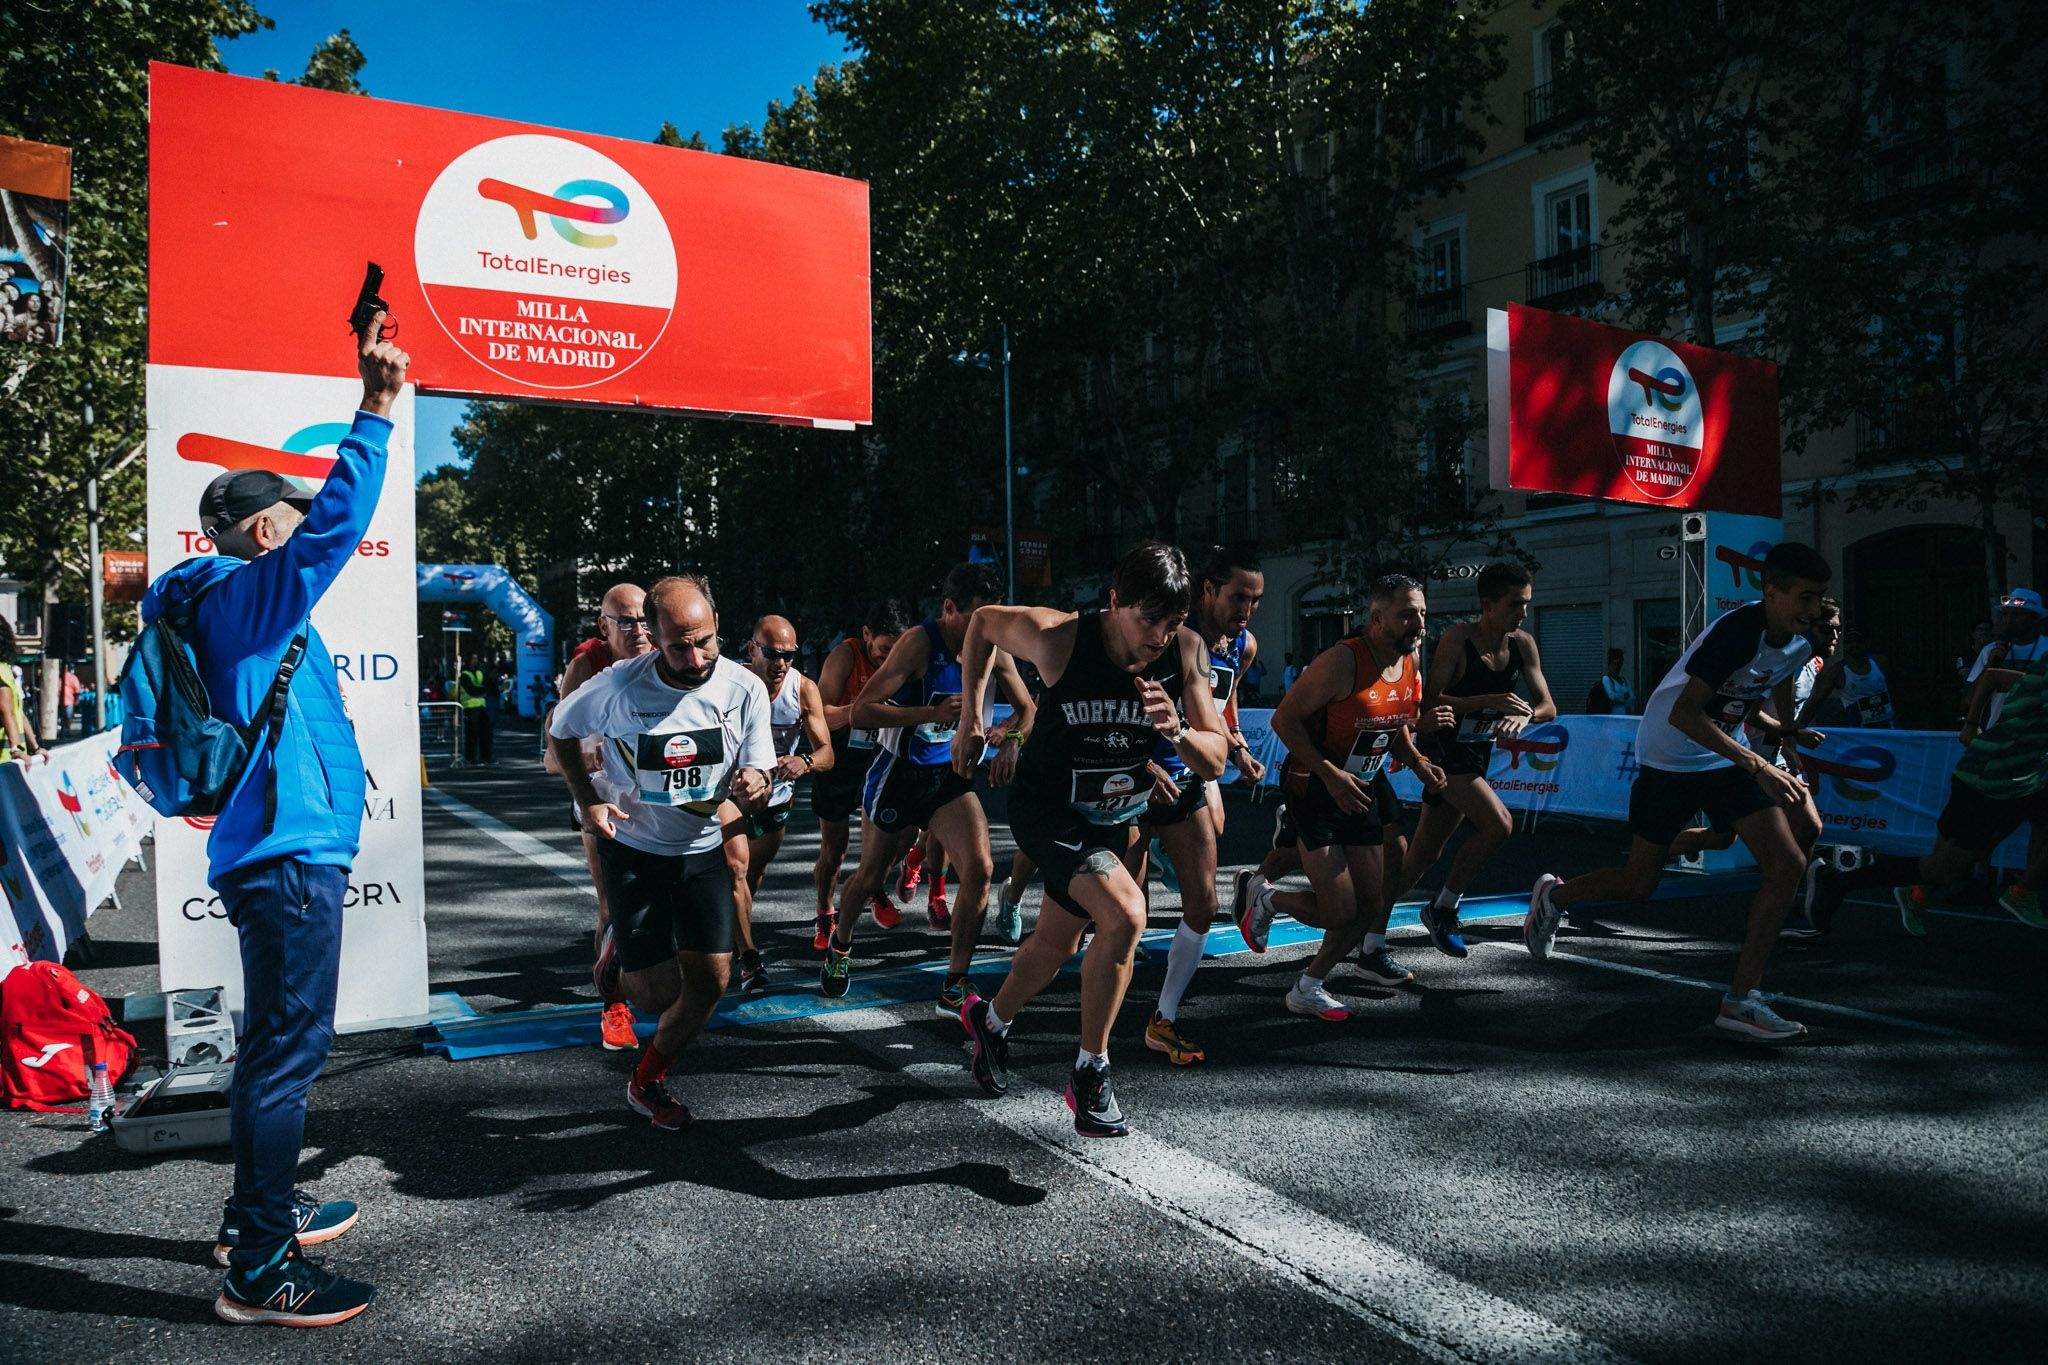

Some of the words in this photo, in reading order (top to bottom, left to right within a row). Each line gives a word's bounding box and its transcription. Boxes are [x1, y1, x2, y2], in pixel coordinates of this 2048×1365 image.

[477, 251, 632, 285] TotalEnergies
[516, 299, 590, 324] MILLA
[488, 342, 521, 362] DE
[526, 345, 616, 370] MADRID
[1630, 412, 1688, 435] TotalEnergies
[1646, 443, 1674, 459] MILLA
[1636, 470, 1649, 483] DE
[1650, 472, 1683, 487] MADRID
[660, 766, 702, 792] 798
